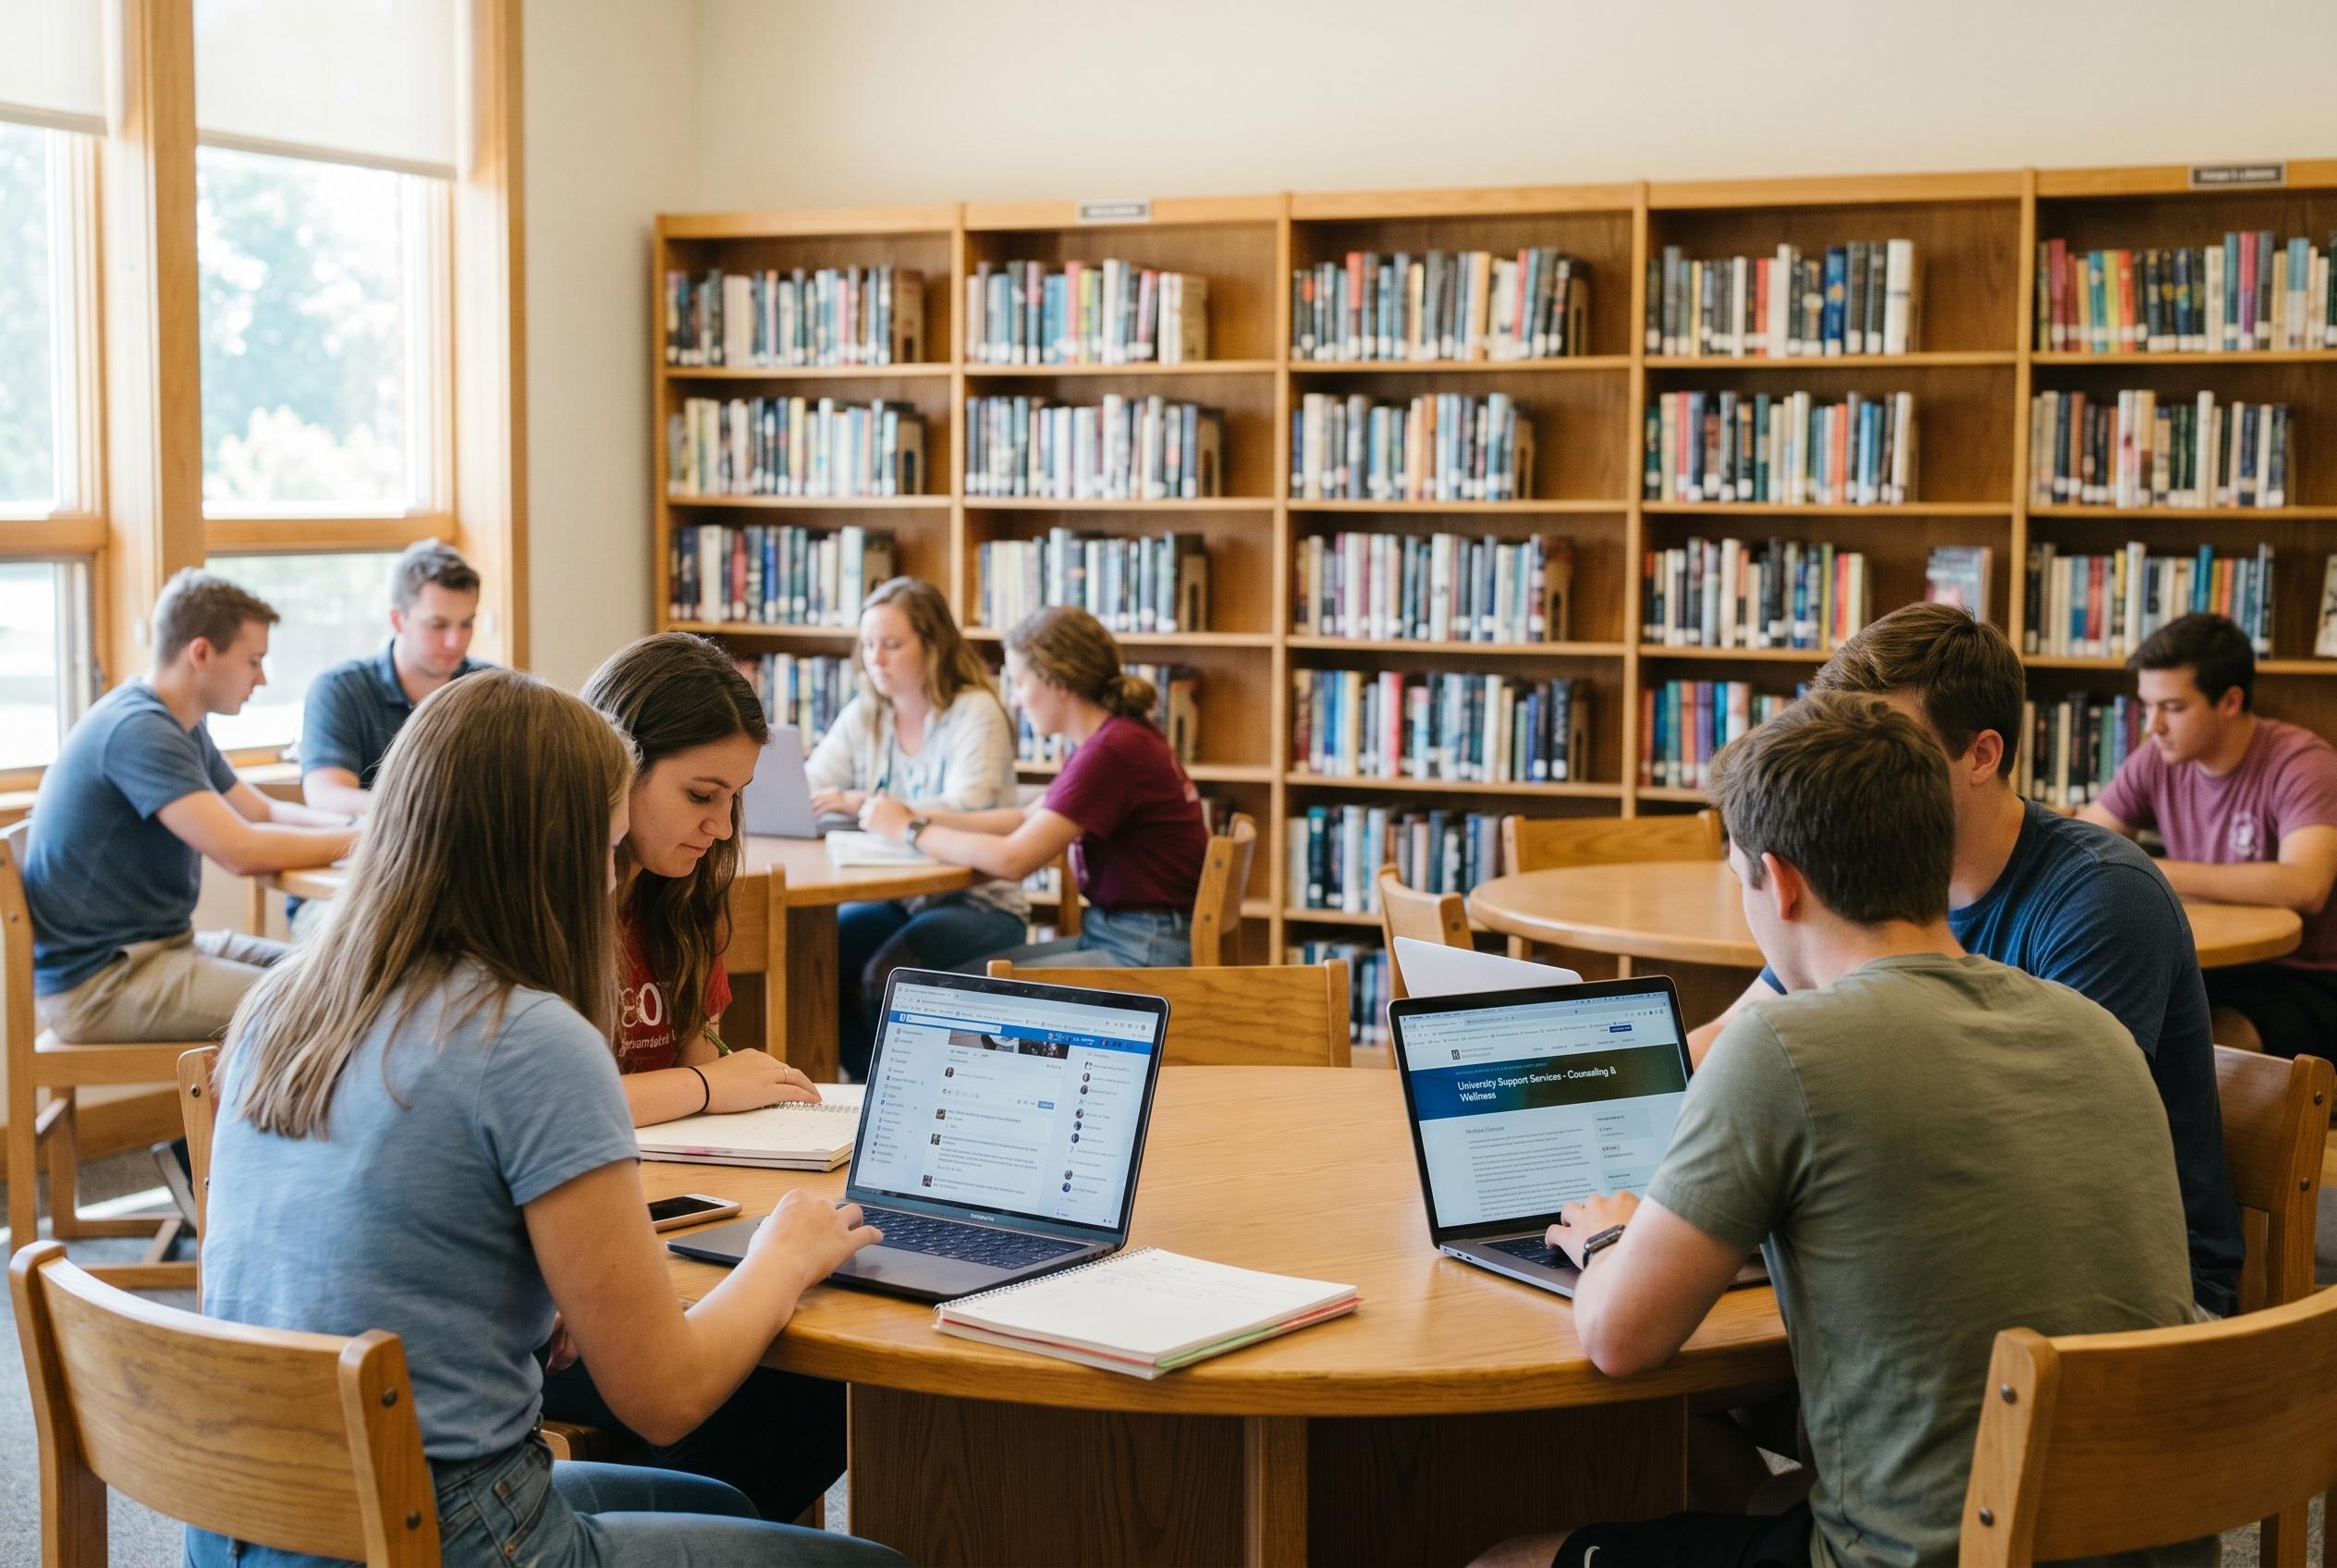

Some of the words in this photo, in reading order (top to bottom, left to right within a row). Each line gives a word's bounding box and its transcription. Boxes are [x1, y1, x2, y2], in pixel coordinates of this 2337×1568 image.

[1458, 1079, 1496, 1090] University
[1498, 1077, 1528, 1087] Support
[1529, 1072, 1561, 1083] Services
[1609, 1066, 1616, 1075] &
